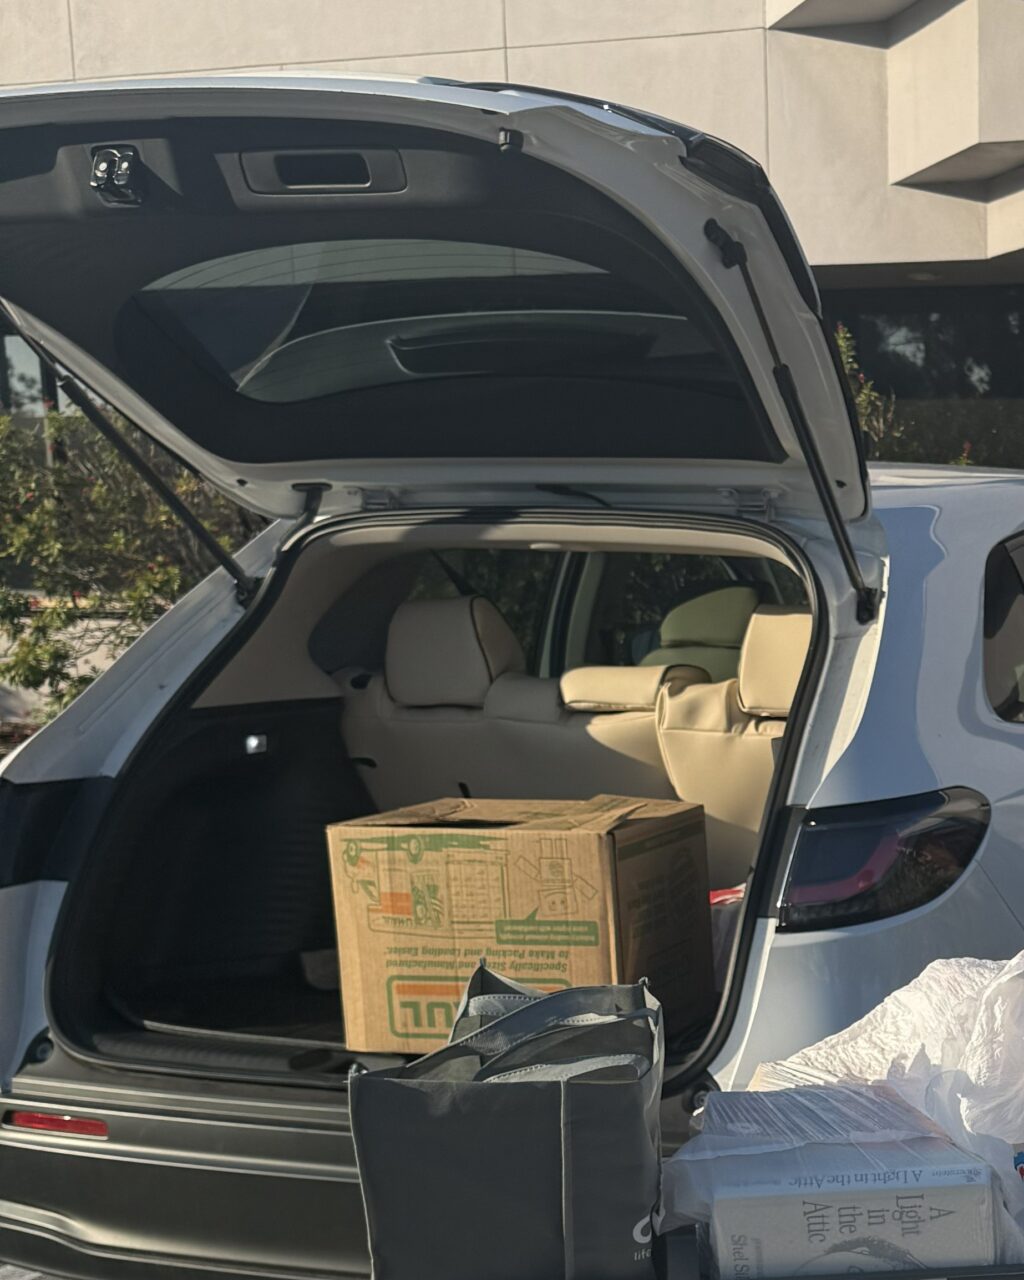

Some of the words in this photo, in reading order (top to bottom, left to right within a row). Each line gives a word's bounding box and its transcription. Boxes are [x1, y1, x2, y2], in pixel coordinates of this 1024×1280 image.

[802, 1200, 834, 1244] Attic
[837, 1204, 863, 1235] the
[867, 1208, 890, 1226] in
[891, 1193, 926, 1238] Light
[929, 1206, 957, 1221] A
